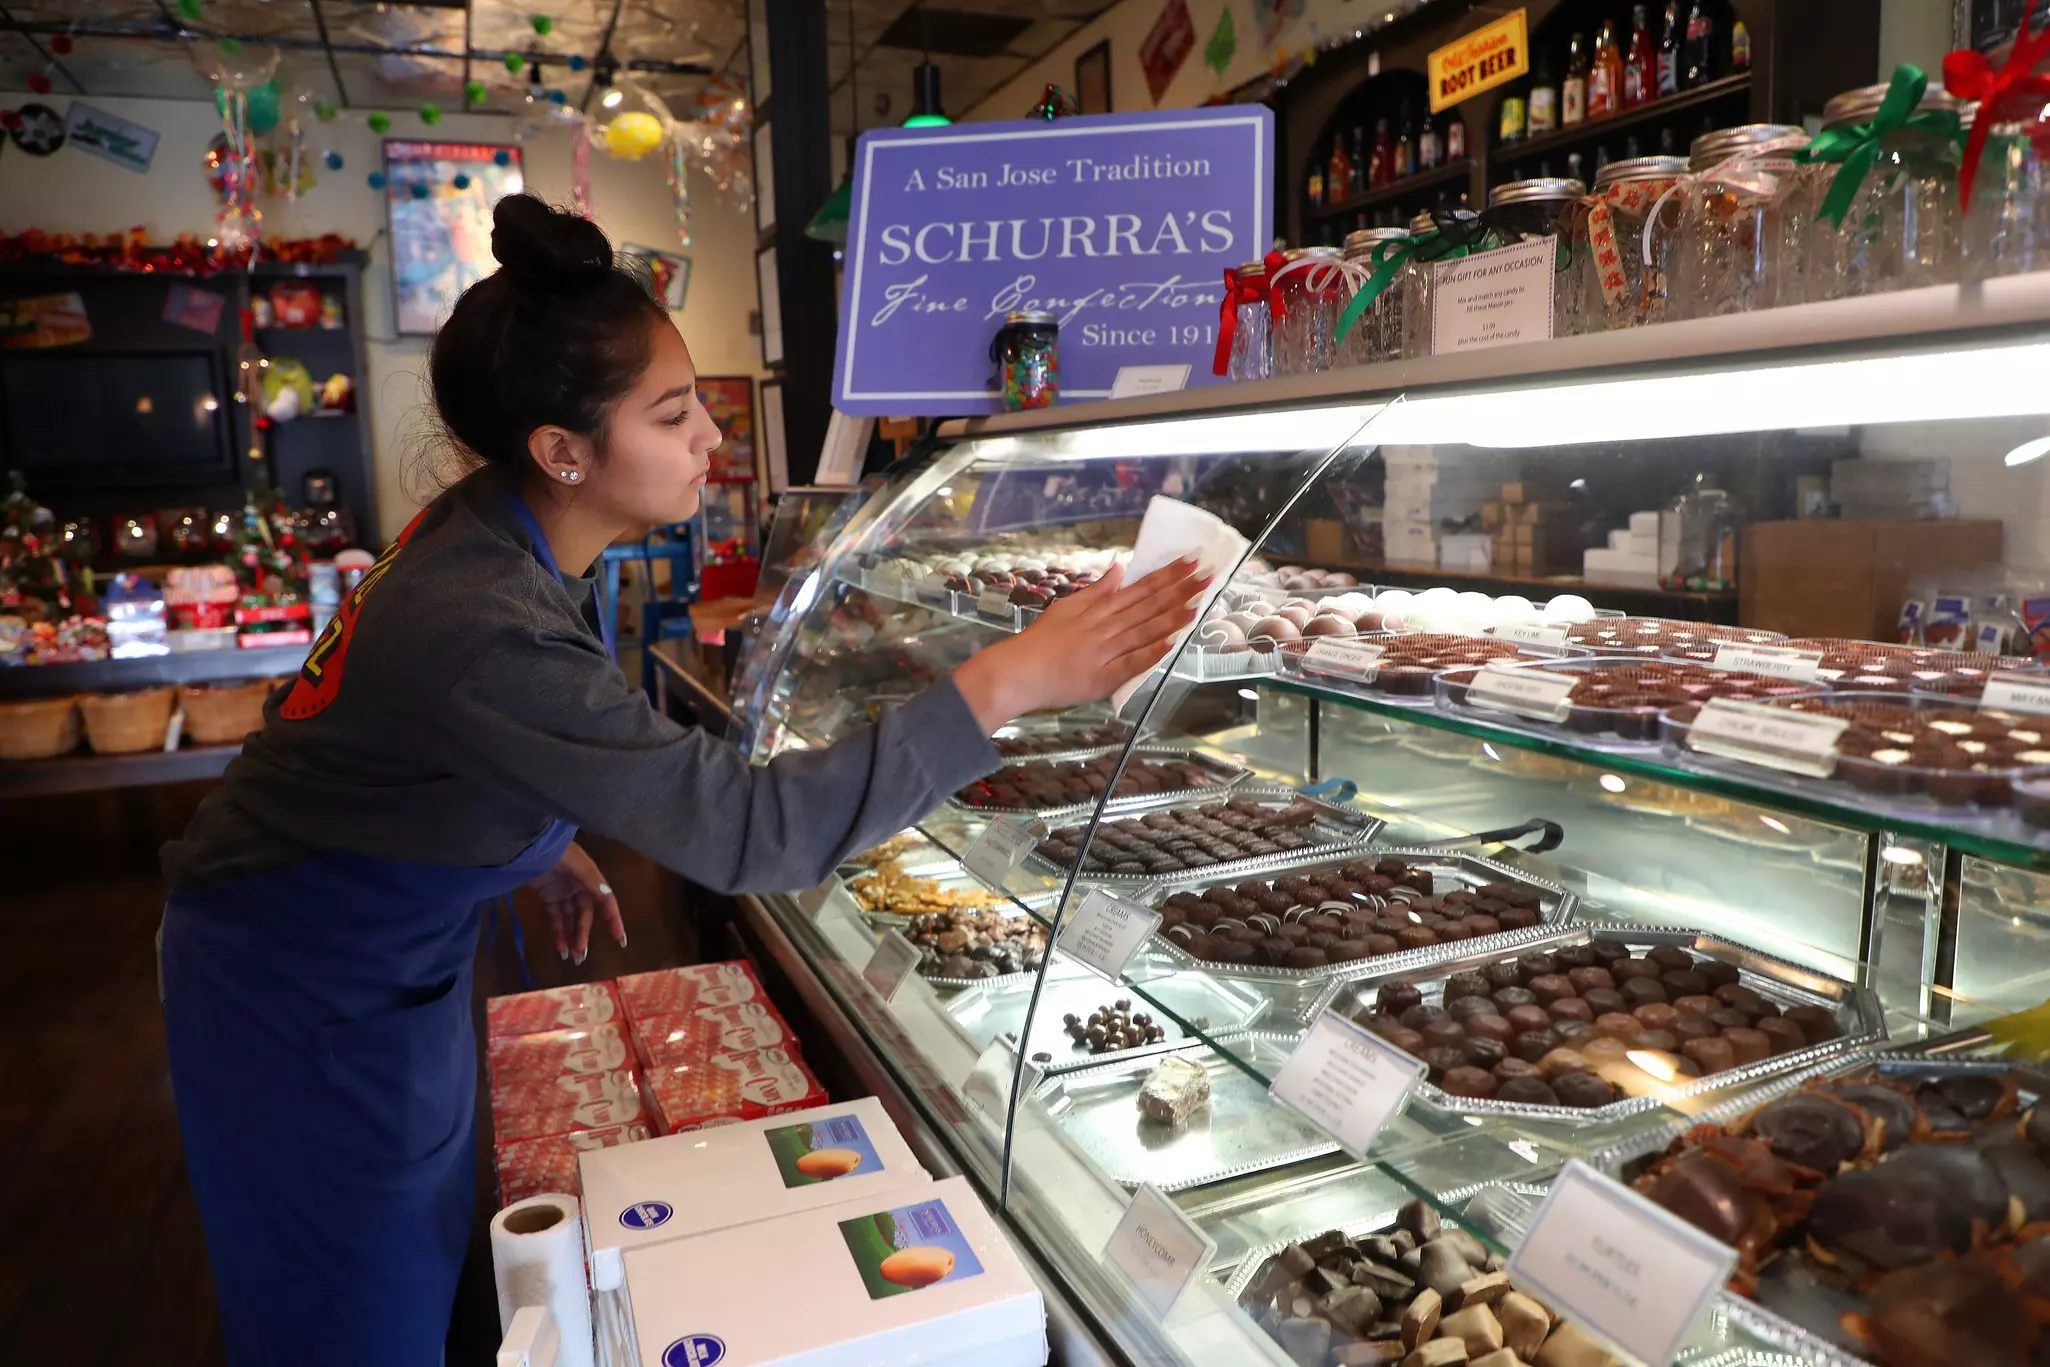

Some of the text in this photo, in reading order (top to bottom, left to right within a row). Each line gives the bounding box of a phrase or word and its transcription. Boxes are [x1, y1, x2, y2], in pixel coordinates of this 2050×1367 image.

[1441, 47, 1516, 98] ROOT BEER
[904, 153, 1211, 193] A San Jose Tradition
[878, 208, 1235, 266] SCHURRA'S
[1457, 272, 1472, 283] GIFT
[1473, 268, 1487, 279] FOR
[1488, 265, 1503, 276] ANY
[870, 273, 1225, 330] Fine Confection
[1457, 286, 1525, 304] Mix and match any candy to
[1473, 302, 1488, 312] these
[1488, 300, 1503, 309] Mason
[1082, 323, 1213, 347] Since 191
[1457, 337, 1469, 346] plus
[1469, 335, 1478, 343] the
[1478, 333, 1490, 342] cost
[1495, 331, 1503, 339] the
[1504, 329, 1520, 339] candy
[1514, 629, 1526, 637] KEY
[1315, 647, 1338, 659] ORANGE
[1105, 904, 1130, 921] CREAMS
[1344, 1038, 1377, 1064] CREAMS
[1136, 1223, 1176, 1268] HONEYCOMB
